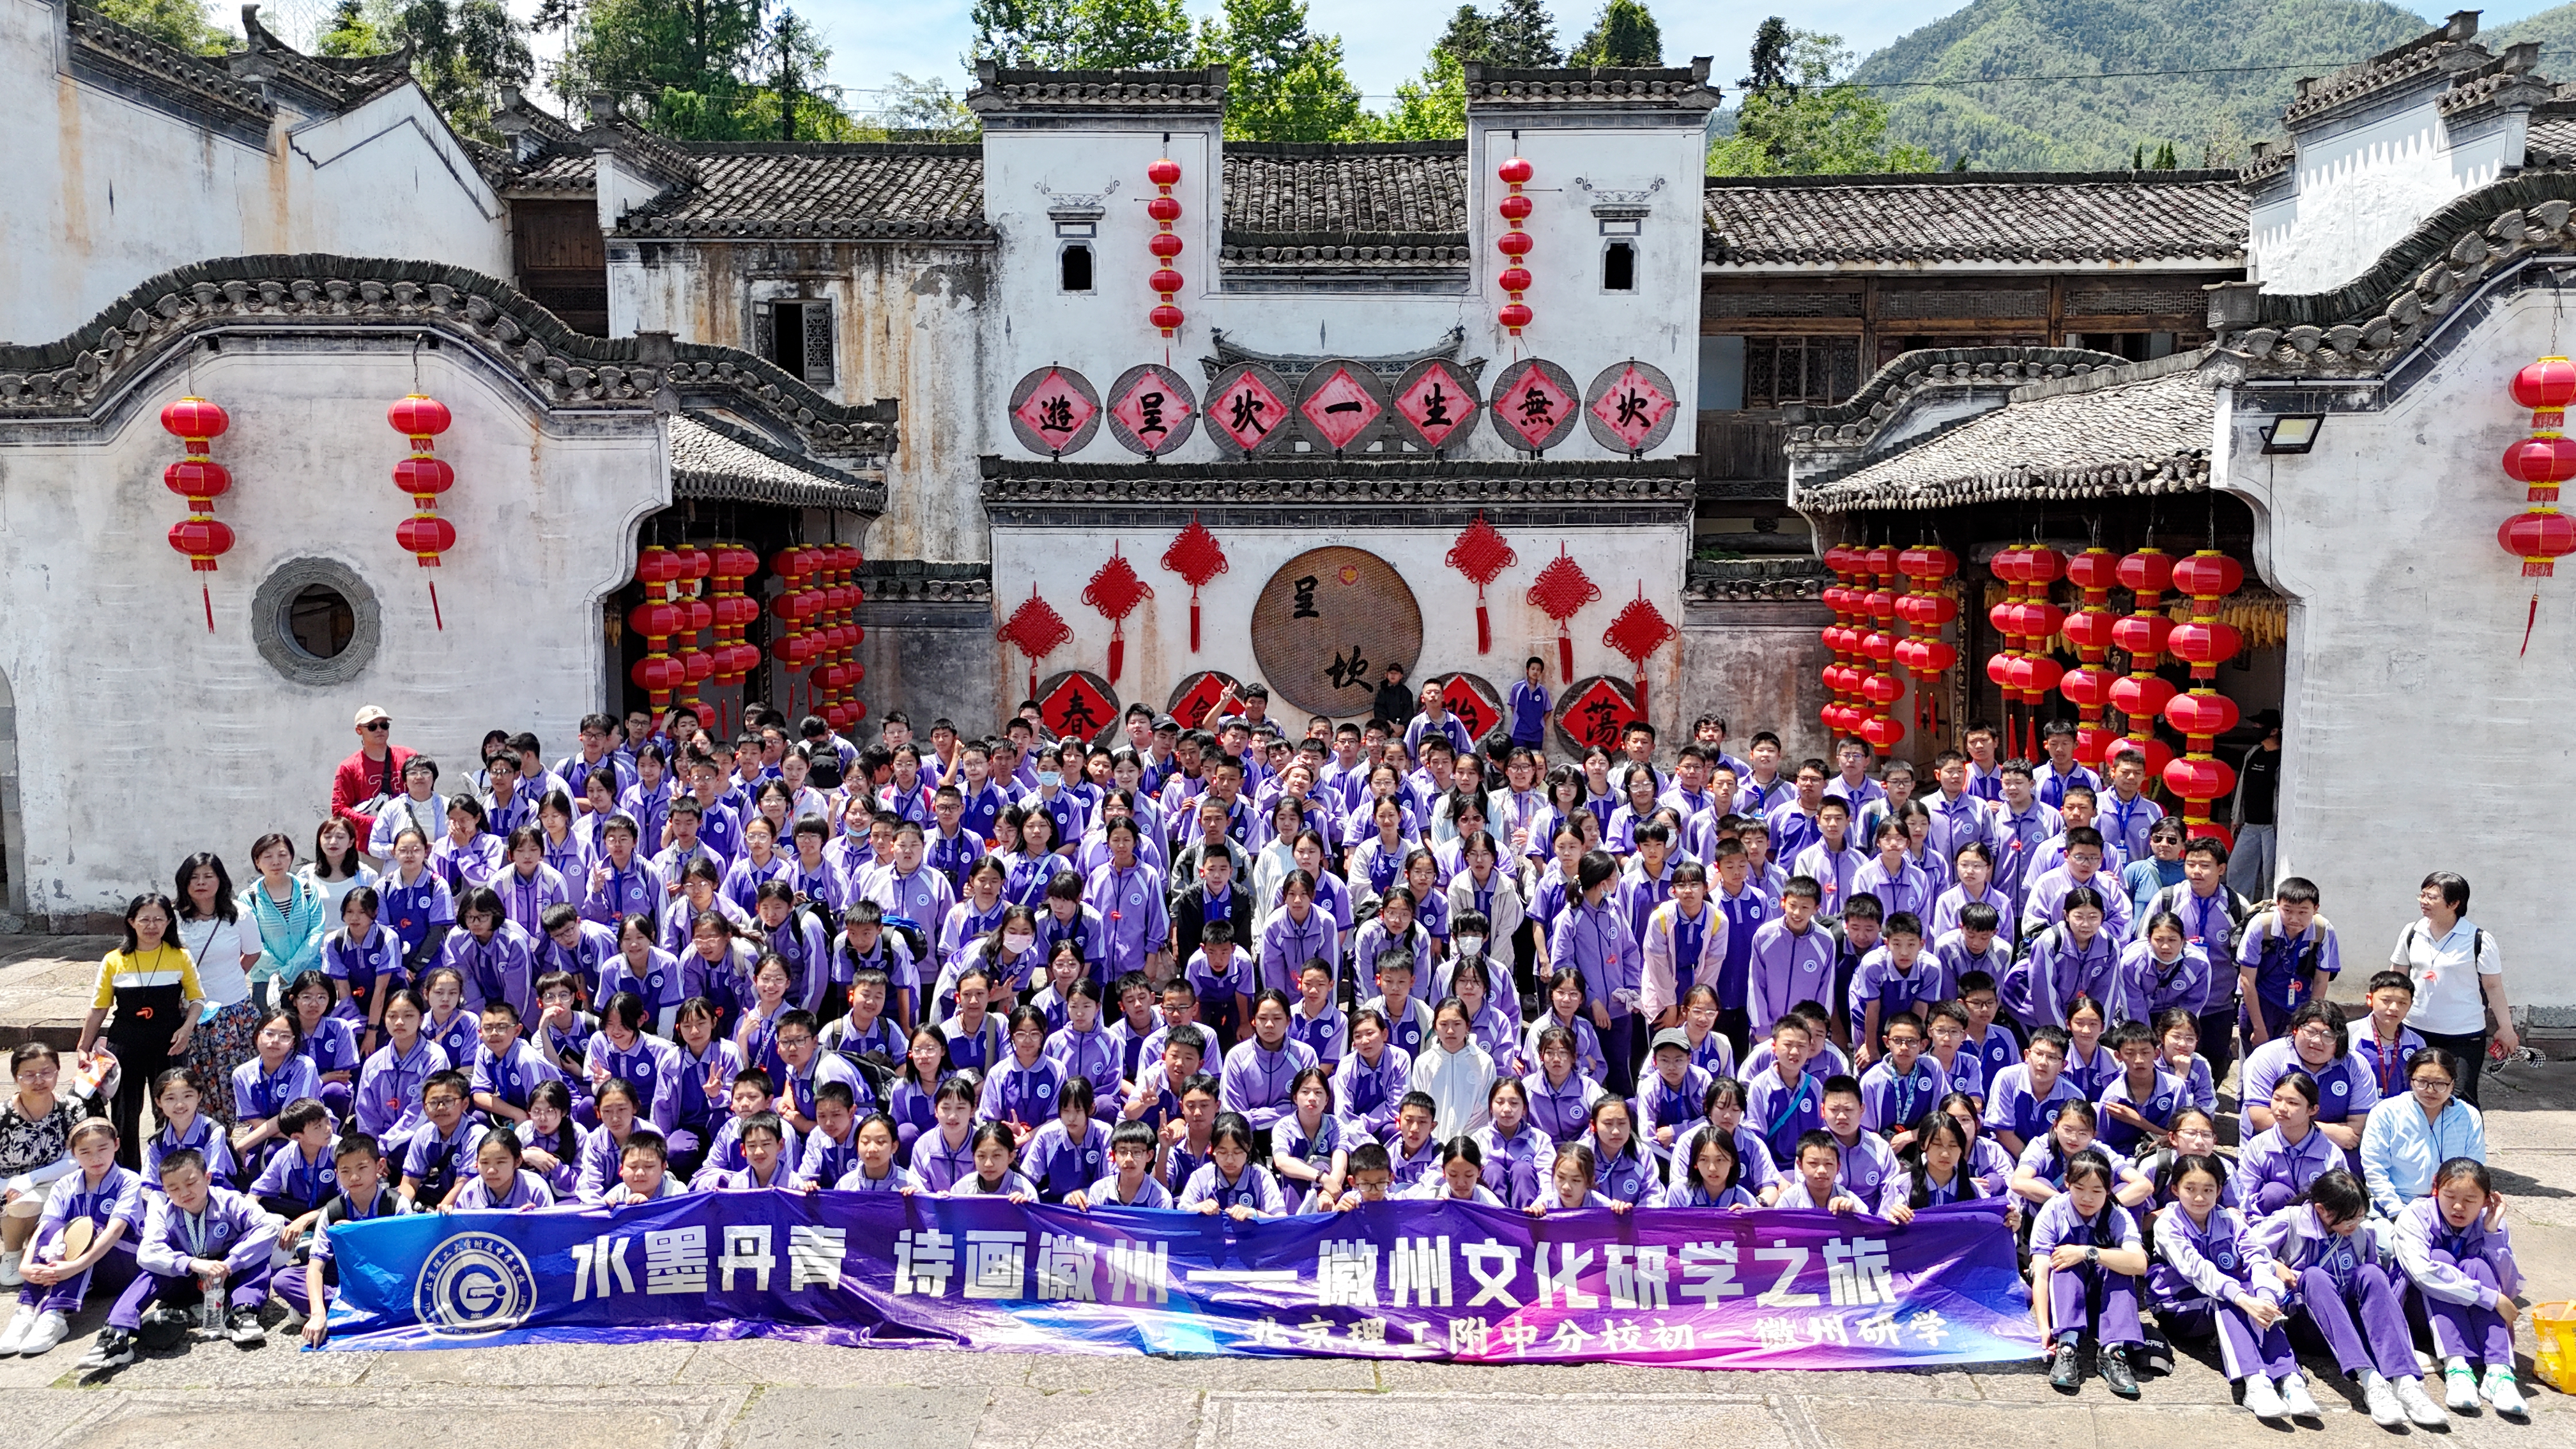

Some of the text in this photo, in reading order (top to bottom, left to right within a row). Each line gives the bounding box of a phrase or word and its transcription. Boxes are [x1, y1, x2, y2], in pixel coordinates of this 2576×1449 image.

[1293, 576, 1373, 693] 呈 坎
[1057, 688, 1101, 735] 春
[572, 1225, 847, 1303] 水墨丹青
